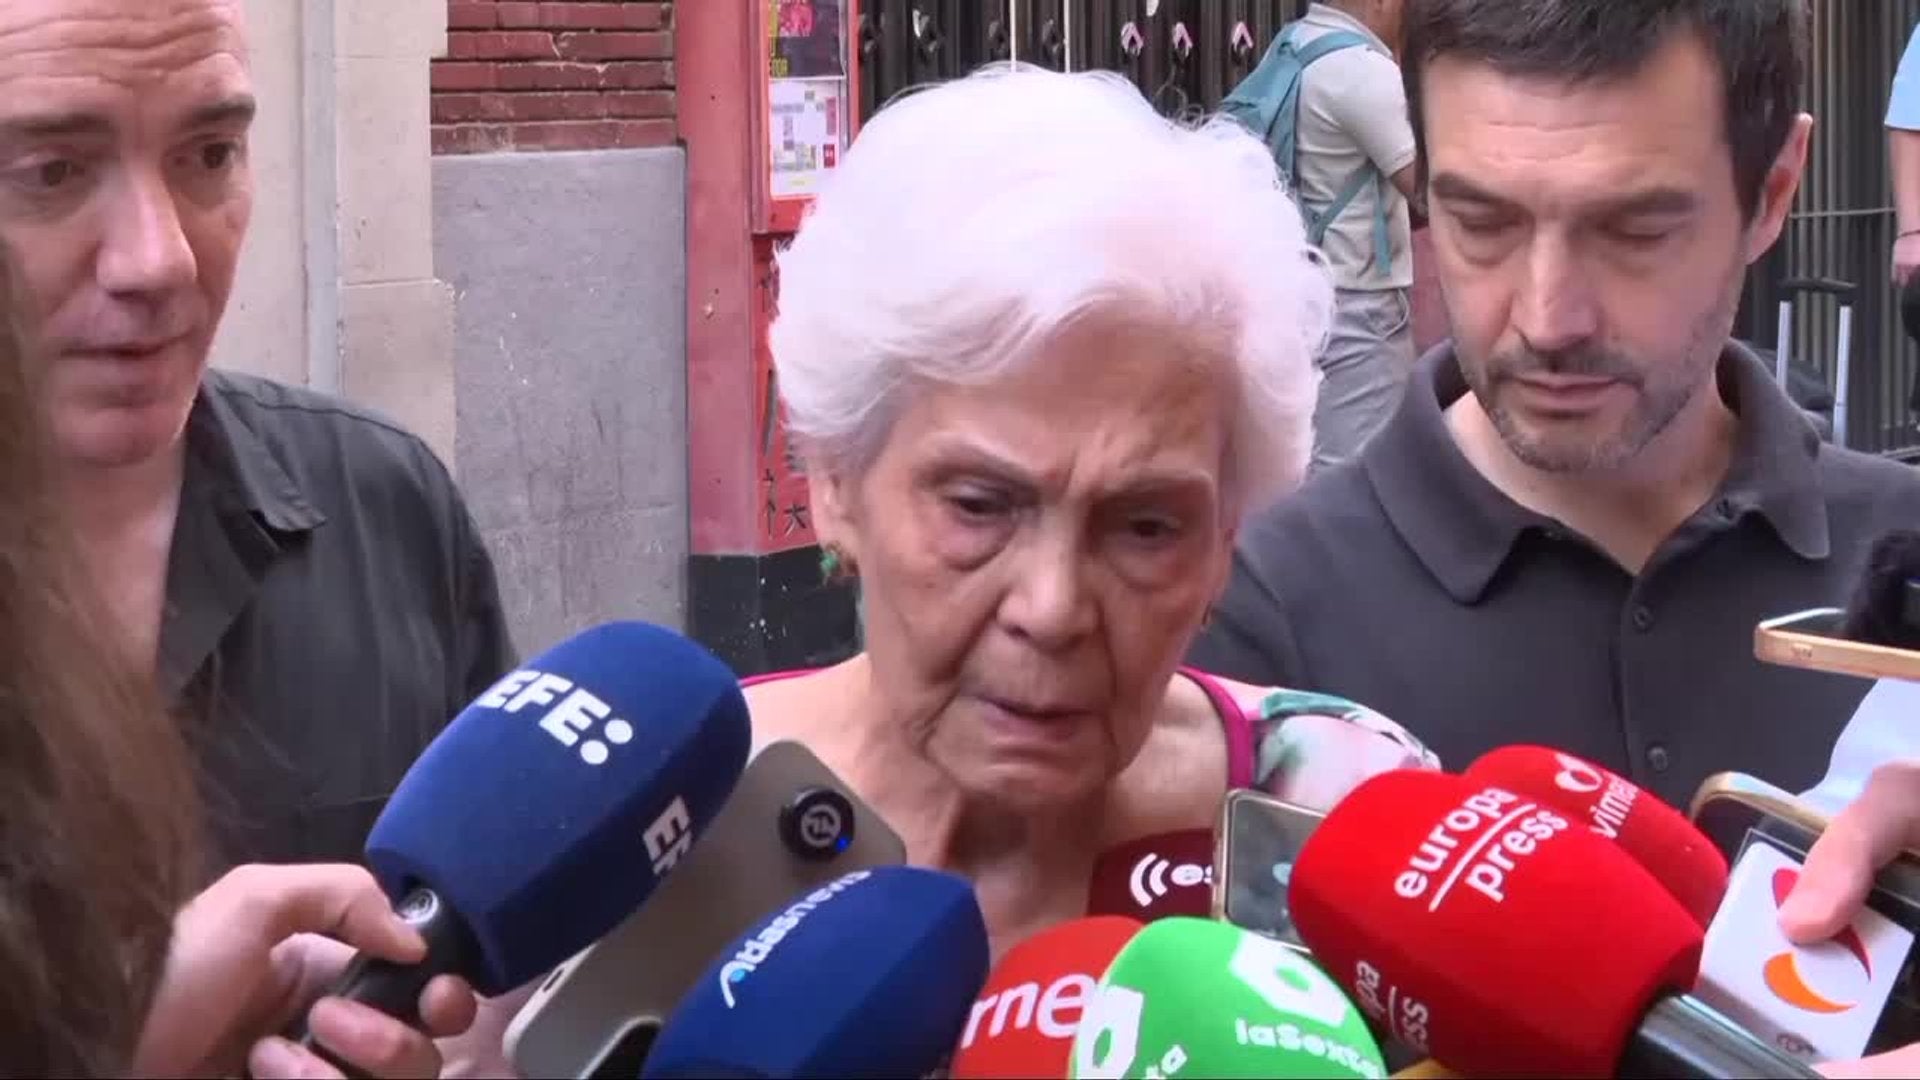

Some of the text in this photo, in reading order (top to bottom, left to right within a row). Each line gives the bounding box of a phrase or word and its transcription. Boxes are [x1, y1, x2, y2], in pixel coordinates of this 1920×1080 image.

[1394, 787, 1519, 899] europa
[1466, 810, 1569, 903] press
[960, 973, 1098, 1049] rne
